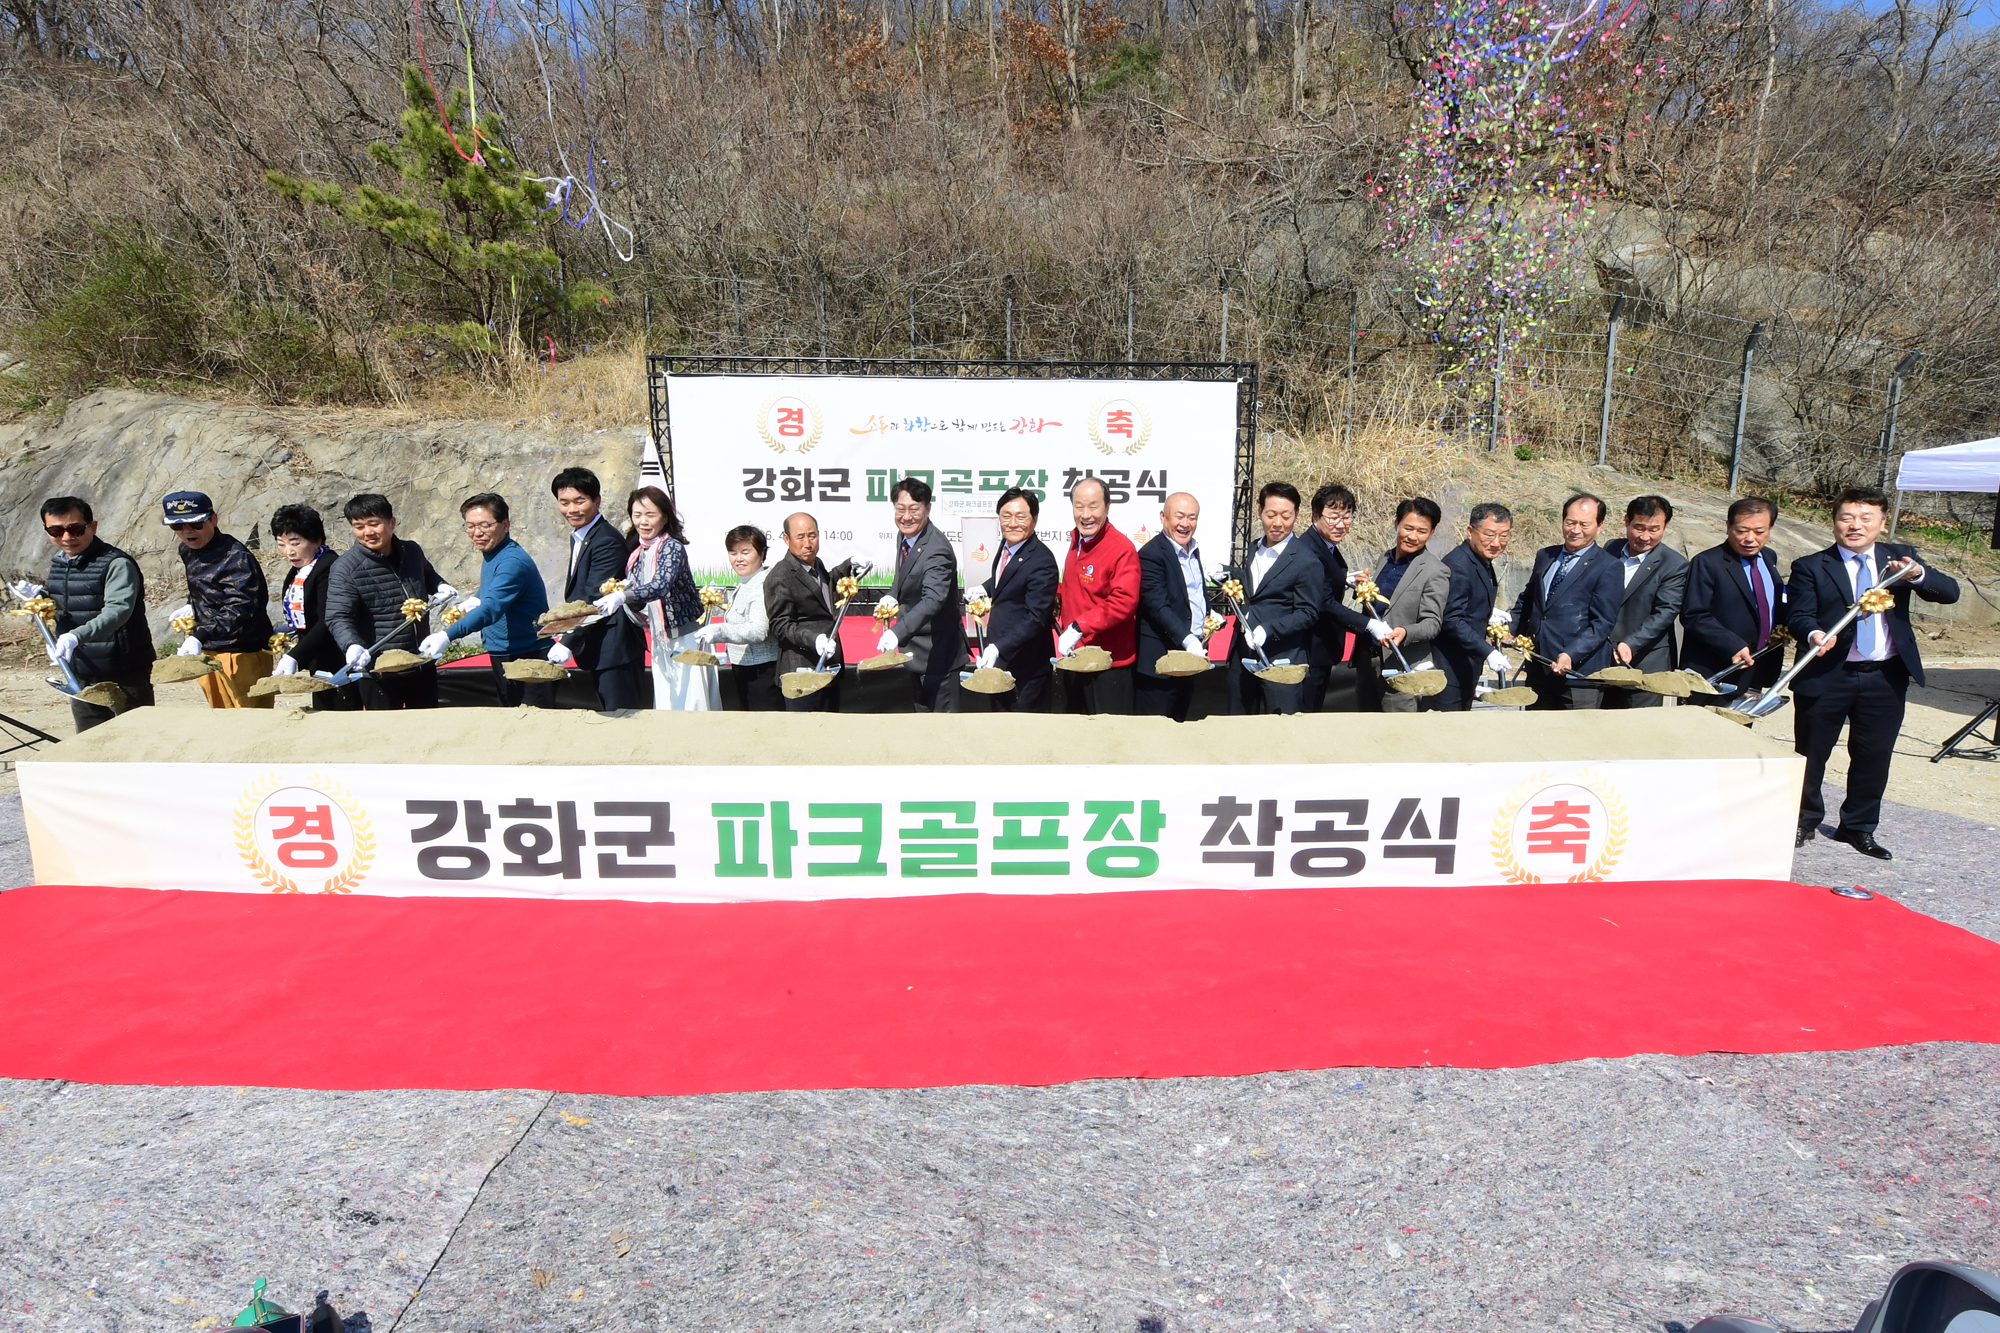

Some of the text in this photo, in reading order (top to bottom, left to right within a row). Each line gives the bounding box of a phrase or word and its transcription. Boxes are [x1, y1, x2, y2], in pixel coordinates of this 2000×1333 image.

[777, 407, 804, 437] 경
[849, 414, 899, 435] 소통과
[951, 418, 978, 433] 함께
[981, 421, 1007, 433] 만드는
[1009, 416, 1063, 435] 강화
[1106, 409, 1134, 439] 축
[742, 466, 851, 503] 강화군
[824, 530, 853, 541] 14:00
[878, 532, 893, 540] 위치
[268, 804, 339, 869] 경
[405, 795, 1460, 881] 강화군 파크골프장 착공식
[1526, 800, 1591, 864] 축
